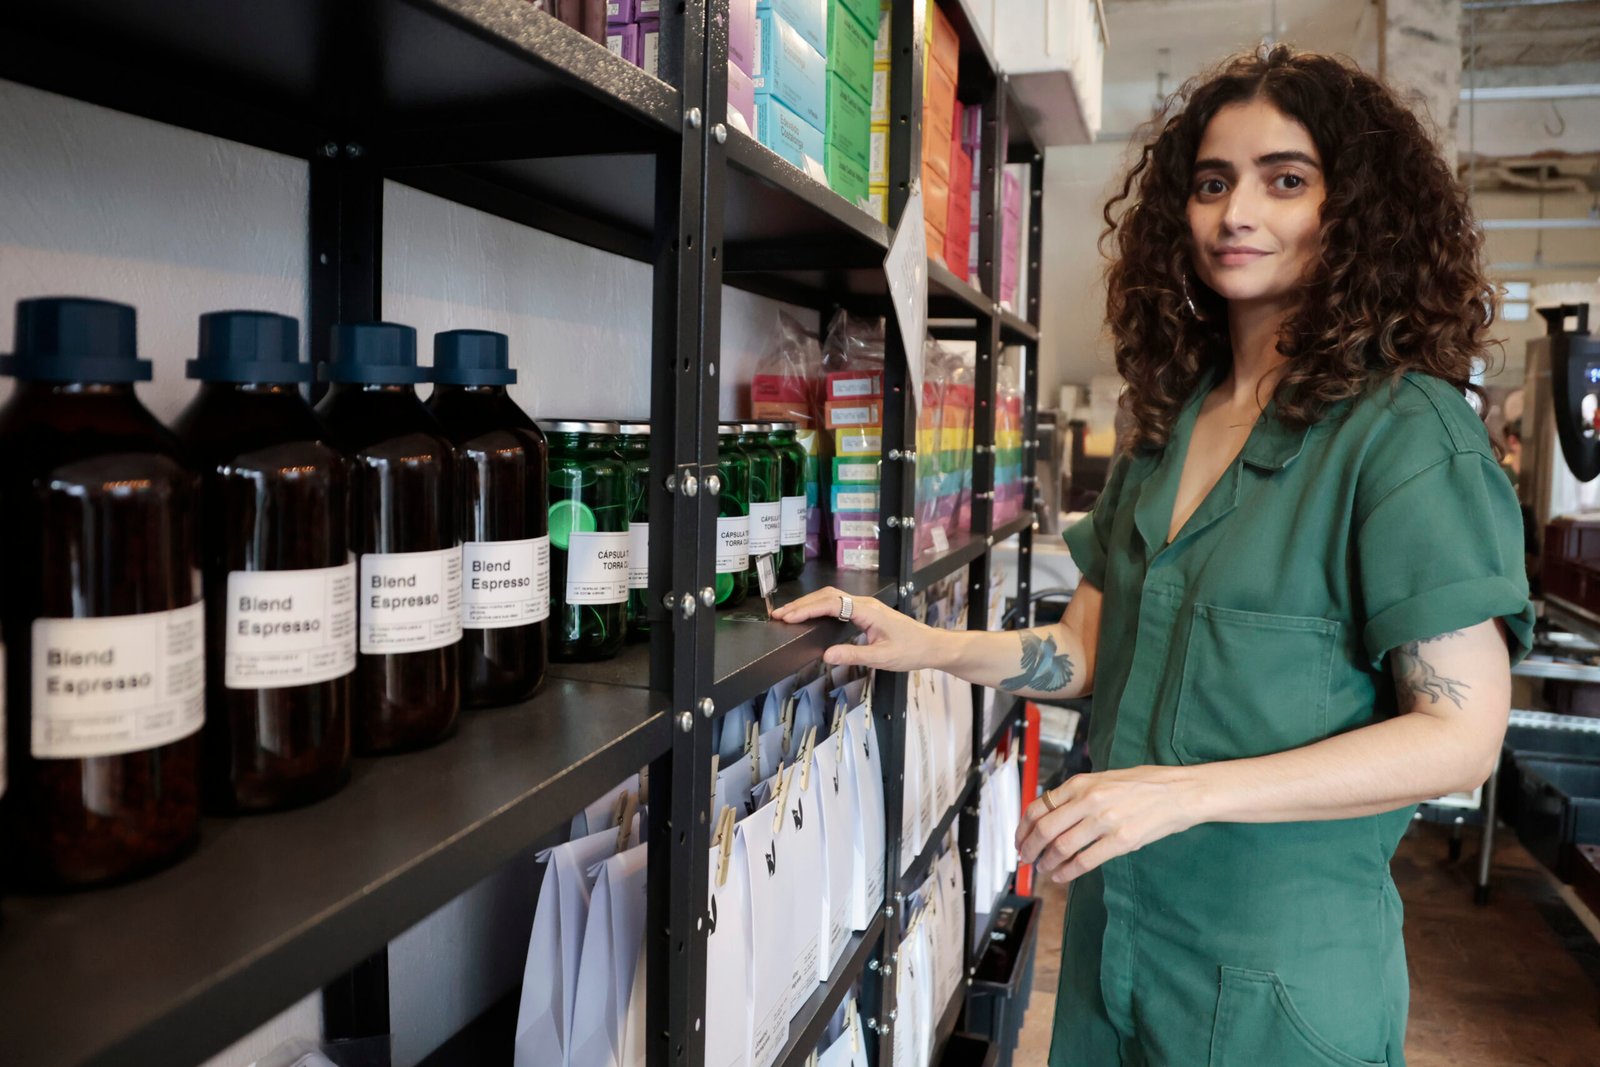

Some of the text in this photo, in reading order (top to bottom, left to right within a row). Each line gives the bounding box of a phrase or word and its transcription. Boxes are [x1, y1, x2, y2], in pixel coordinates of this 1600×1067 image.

[720, 530, 745, 539] CÁPSULA
[725, 539, 742, 547] TORRA
[597, 549, 625, 560] CÁPSULA
[472, 560, 511, 572] Blend
[602, 561, 623, 570] TORRA
[371, 574, 416, 588] Blend
[471, 577, 530, 592] Espresso
[238, 595, 292, 612] Blend
[370, 593, 439, 611] Espresso
[237, 619, 320, 638] Espresso
[46, 647, 114, 667] Blend
[46, 672, 152, 698] Espresso
